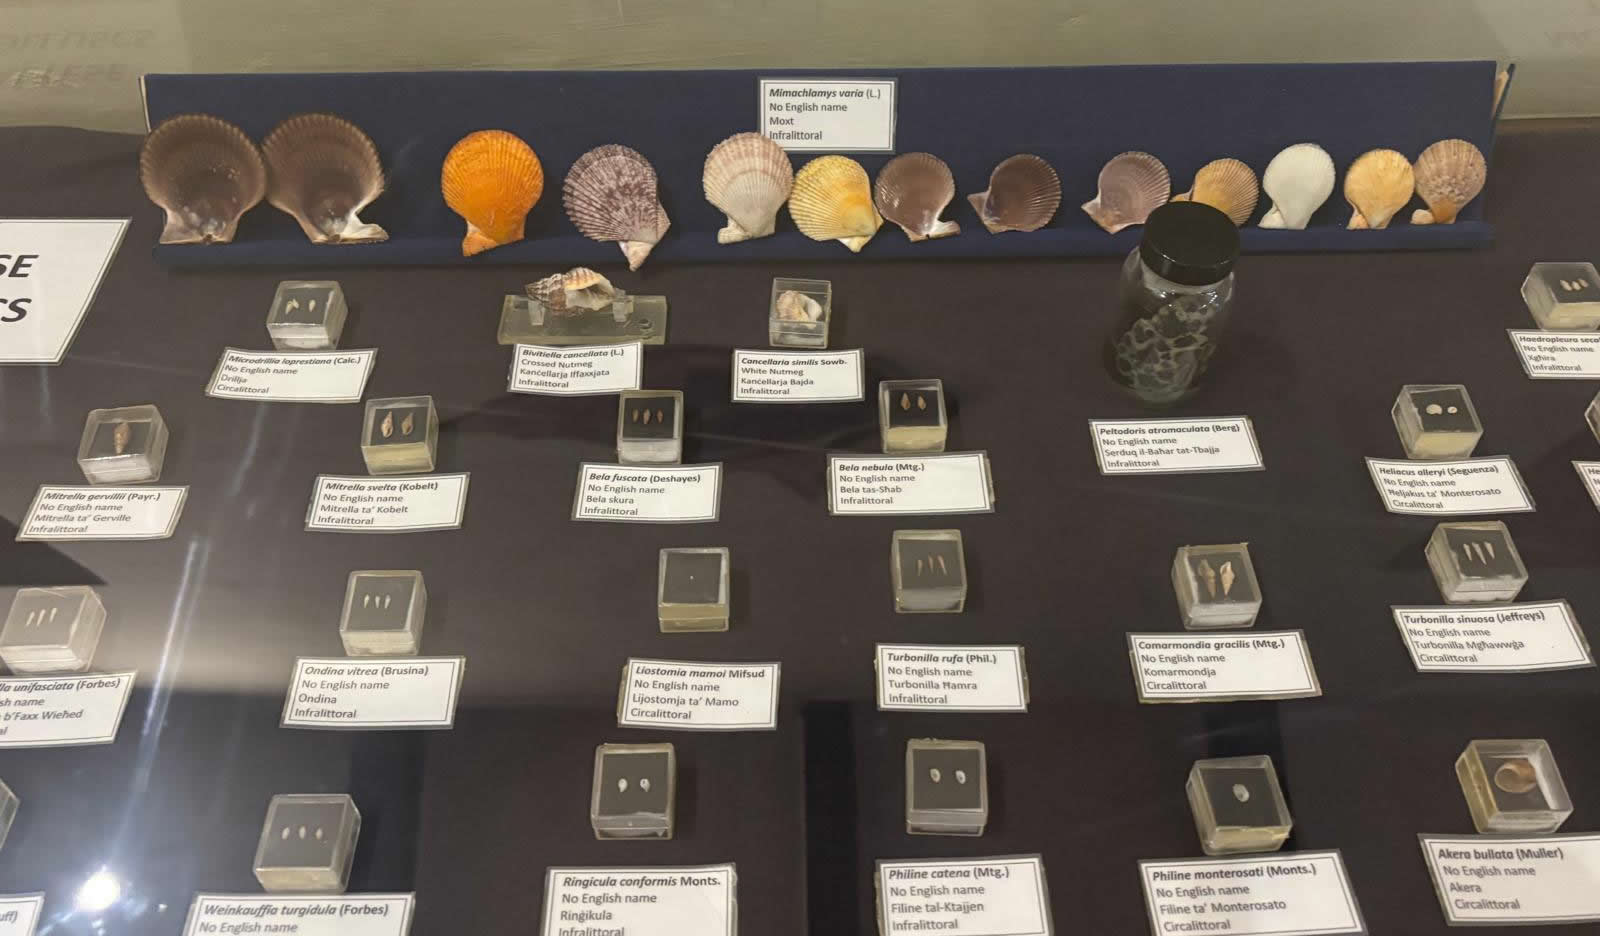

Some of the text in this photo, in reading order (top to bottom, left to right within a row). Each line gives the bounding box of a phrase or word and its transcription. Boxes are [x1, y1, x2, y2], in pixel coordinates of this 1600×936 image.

[769, 88, 881, 99] Mimachlamys varia (L.)
[770, 103, 783, 111] No
[786, 103, 818, 113] English
[770, 117, 794, 125] Moxt
[770, 131, 822, 140] Infralittoral
[523, 349, 624, 359] Bivitiella cancellata (L.)
[229, 356, 361, 366] Microdrillia loprestiana (Calc.)
[522, 359, 556, 367] Crossed
[770, 368, 803, 376] Nutmeg
[1148, 426, 1210, 434] atromaculata
[1212, 424, 1240, 433] (Berg)
[896, 463, 924, 472] (Mtg.)
[1108, 460, 1159, 468] Infralittoral
[1380, 467, 1415, 476] Heliacus
[1448, 465, 1498, 476] (Seguenza)
[589, 473, 700, 483] Bela fuscata (Deshayes)
[856, 475, 887, 484] English
[326, 482, 438, 492] Mitrella svelta (Kobelt)
[128, 493, 161, 501] (Payr.)
[587, 495, 634, 504] Bela skura
[321, 505, 358, 513] Mitrella
[585, 507, 638, 515] Infralittoral
[318, 516, 373, 525] Infralittoral
[1404, 610, 1545, 624] Turbonilla sinuosa (Jeffreys)
[1139, 639, 1285, 651] Comarmondia gracilis (Mtg.)
[1414, 640, 1464, 649] Turbonilla
[888, 652, 996, 664] Turbonilla rufa (Phil.)
[1142, 654, 1225, 664] No English name
[1420, 654, 1477, 663] Circalittoral
[305, 665, 428, 677] Ondina vitrea (Brusina)
[636, 666, 765, 678] Liostomia mamoi Mifsud
[888, 667, 972, 677] No English name
[1144, 667, 1216, 678] Komarmondja
[14, 681, 73, 693] unifasciata
[77, 678, 120, 691] (Forbes)
[302, 680, 317, 688] No
[321, 680, 357, 691] English
[634, 680, 720, 691] No English name
[889, 680, 940, 689] Turbonilla
[1147, 681, 1206, 690] Circalittoral
[298, 693, 337, 704] Ondina
[705, 698, 739, 706] Mamo
[295, 708, 356, 718] Infralittoral
[631, 708, 692, 719] Circalittoral
[1438, 848, 1563, 860] Akera bullata (Muller)
[889, 867, 1009, 880] Philine catena (Mtg.)
[1153, 864, 1316, 881] Philine monterosati (Monts.)
[1444, 866, 1536, 878] No English name
[563, 876, 720, 889] Ringicula conformis Monts.
[1450, 882, 1482, 893] Akera
[890, 886, 984, 898] No English name
[1156, 886, 1250, 899] No English name
[562, 893, 656, 905] No English name
[1455, 899, 1520, 910] Circalittoral
[281, 905, 336, 917] turgidula
[340, 904, 389, 917] (Forbes)
[891, 902, 922, 913] Filine
[1160, 905, 1195, 915] Filine
[1211, 901, 1286, 913] Monterosato
[892, 919, 958, 931] Infralittoral
[1164, 920, 1231, 932] Circalittoral
